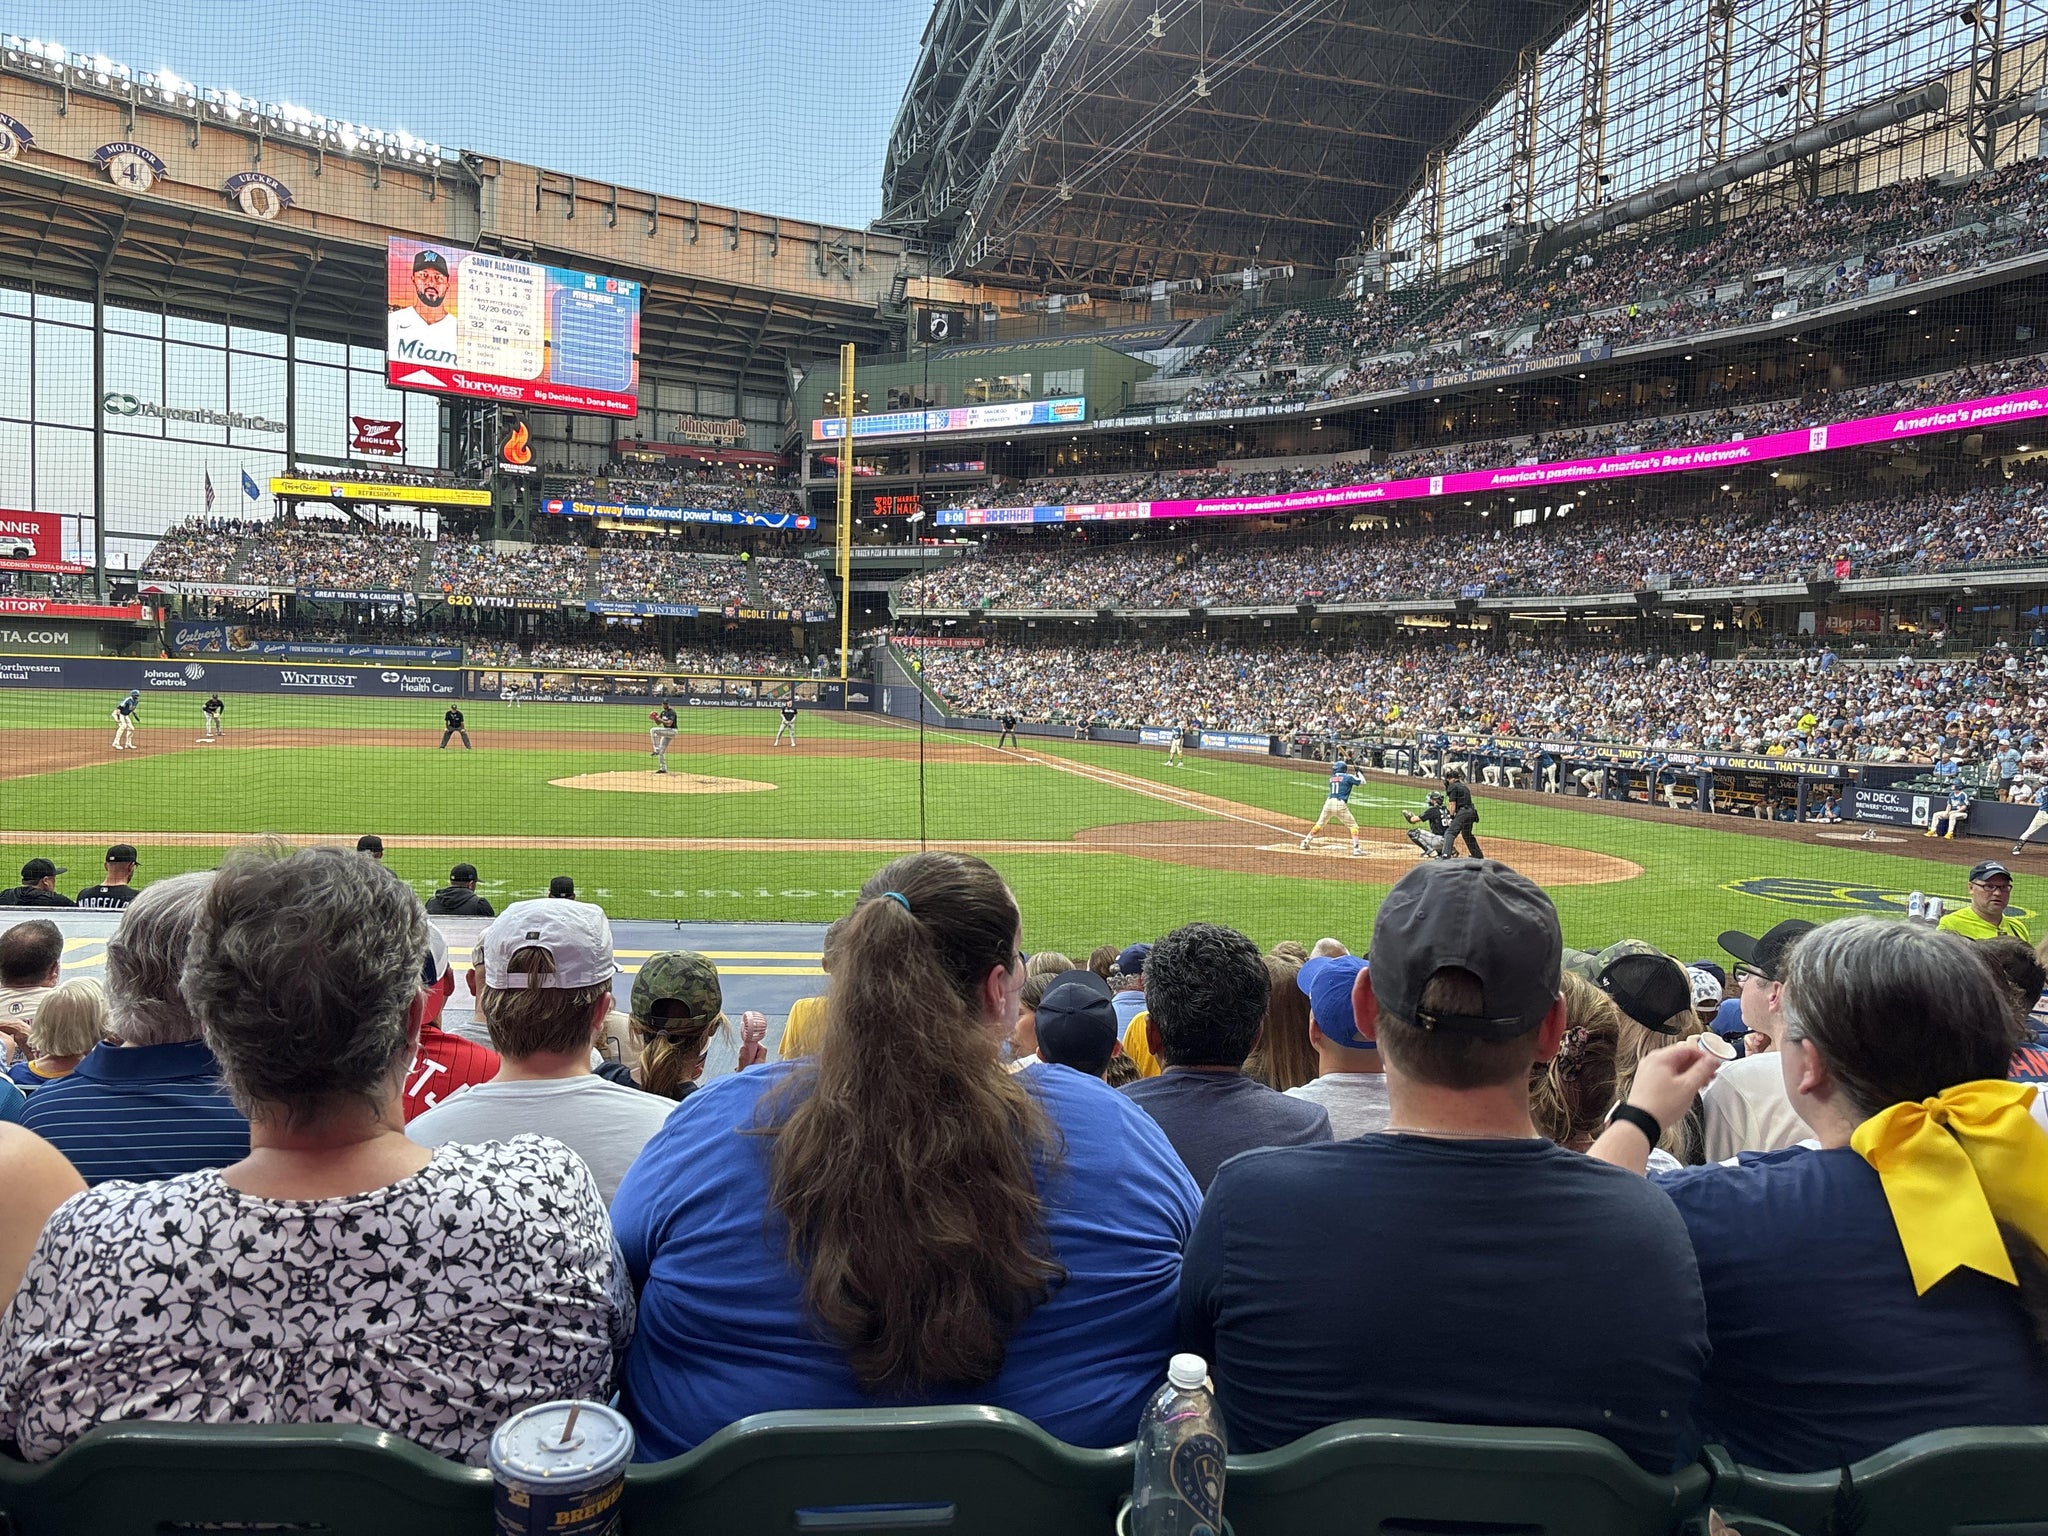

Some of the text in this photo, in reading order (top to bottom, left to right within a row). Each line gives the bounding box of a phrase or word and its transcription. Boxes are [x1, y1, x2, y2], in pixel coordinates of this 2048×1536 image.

[106, 143, 156, 164] MOLITOR
[122, 162, 138, 183] 4
[239, 173, 279, 189] UECKER
[472, 257, 530, 276] SANDY ALCANTARA
[478, 304, 499, 312] 12/20
[471, 320, 484, 328] 32
[518, 328, 530, 336] 76
[1034, 340, 1063, 349] THE
[1433, 352, 1582, 388] BREWERS COMMUNITY FOUNDATION
[535, 390, 631, 410] Big Decisions, Done Better.
[145, 401, 286, 433] Aurora Health Care
[1893, 398, 2043, 433] America's pastime.
[363, 423, 392, 437] Miller
[675, 414, 746, 437] Johnsonville
[360, 436, 395, 446] HIGH LIFE
[686, 433, 710, 442] PARTY
[368, 448, 386, 456] LOFT
[1491, 446, 1751, 486] America's pastime. America's Best Network.
[281, 481, 319, 492] Topo Chico
[358, 490, 400, 498] REFRESHMENT
[896, 495, 920, 503] MARKET
[1195, 488, 1386, 513] America's pastime. America's Best Network.
[572, 502, 733, 522] Stay away from downed power lines
[0, 521, 40, 534] NNER
[0, 560, 82, 572] ISCONSIN TOYOTA DEALERS
[169, 582, 268, 598] ShoreWEST.COM
[314, 590, 336, 598] GREAT
[370, 592, 403, 600] CALORIES.
[447, 595, 514, 608] 620 WTMJ
[517, 602, 557, 610] BREWERS
[646, 604, 692, 615] WINTRUST
[738, 608, 789, 620] NICOLET LAW
[0, 630, 69, 645] TA.COM
[176, 626, 223, 645] Culver's
[264, 644, 286, 653] Culver's
[349, 646, 370, 656] Culver's
[431, 649, 452, 658] Culver's
[0, 663, 60, 672] orthwestern
[0, 672, 28, 680] utual
[144, 670, 180, 678] Johnson
[280, 671, 355, 684] WINTRUST
[401, 674, 431, 684] Aurora
[150, 678, 187, 686] Controls
[401, 684, 454, 693] Health Care
[756, 700, 788, 708] BULLPEN
[1228, 736, 1250, 744] OFFICIAL
[1560, 744, 1575, 752] LAW
[1728, 758, 1746, 768] ONE
[1806, 764, 1828, 774] ALL!
[1331, 782, 1340, 794] 11
[1856, 791, 1900, 804] ON DECK:
